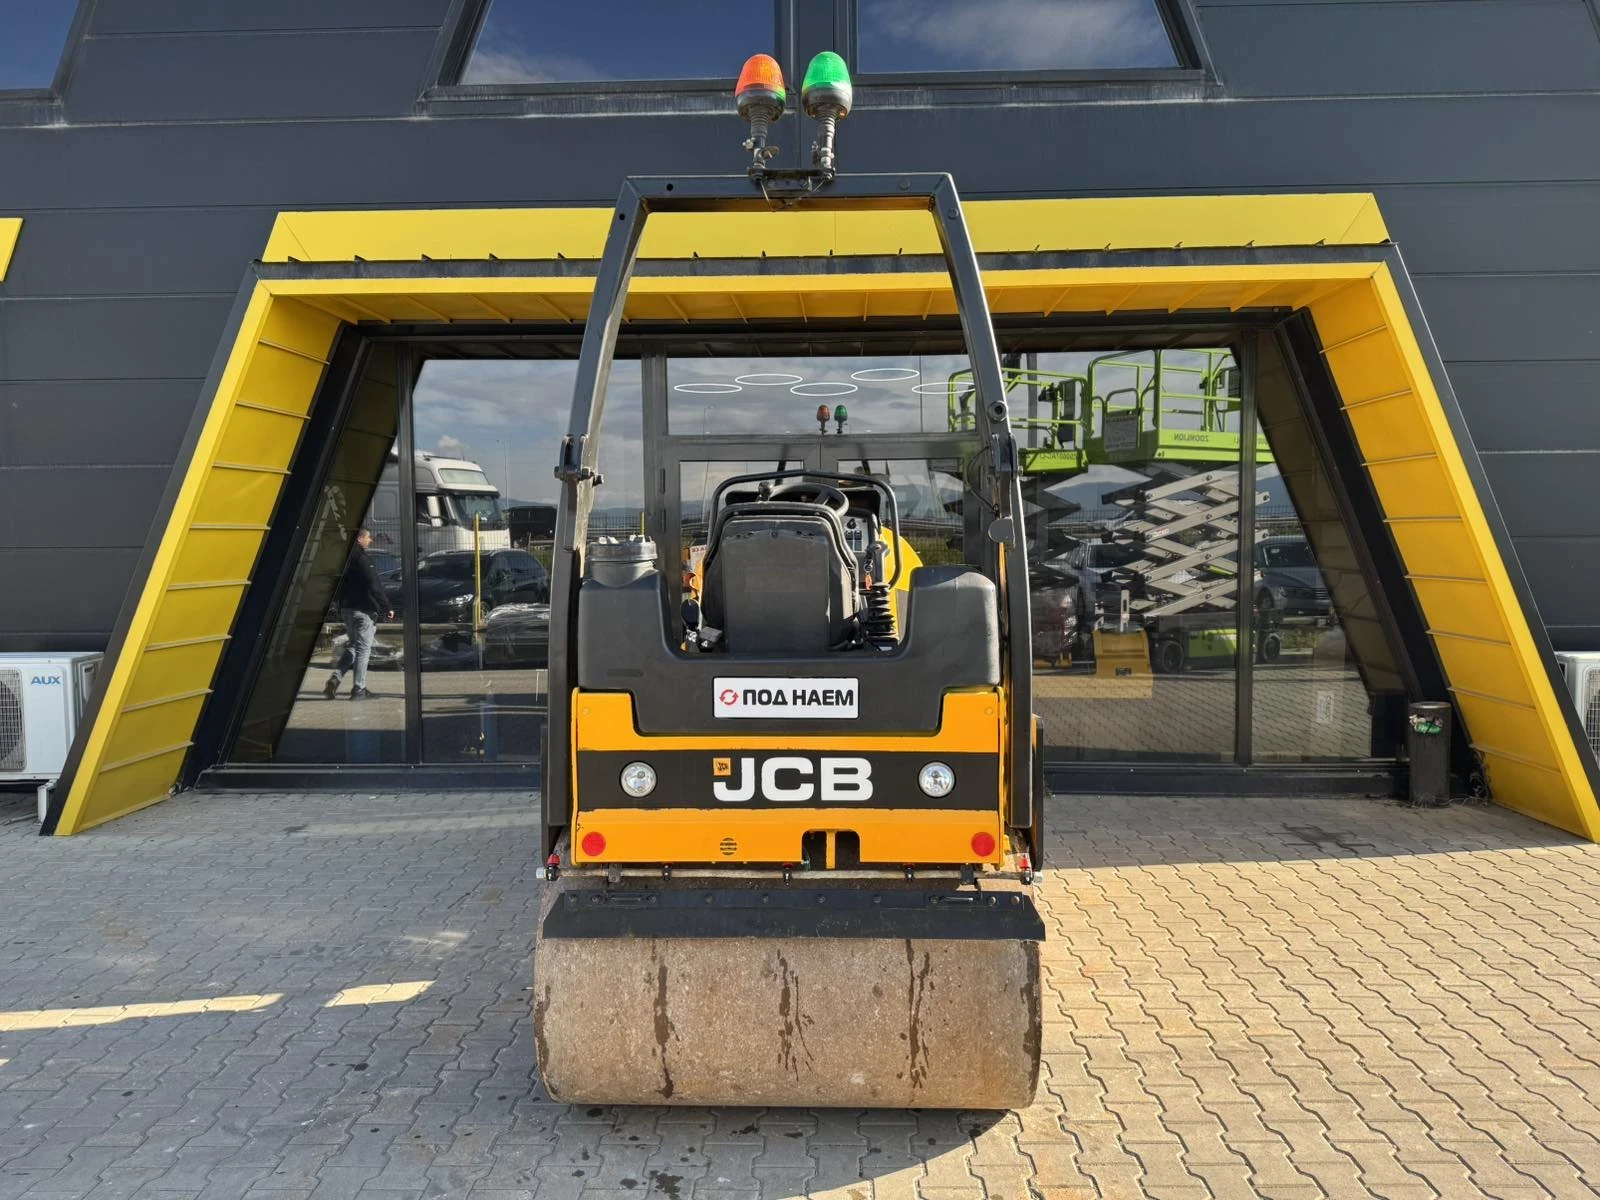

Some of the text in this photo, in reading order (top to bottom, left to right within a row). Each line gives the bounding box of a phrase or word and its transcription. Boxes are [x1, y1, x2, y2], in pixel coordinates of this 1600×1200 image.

[31, 676, 61, 685] AUX
[743, 689, 854, 706] ПОД НАЕМ
[713, 757, 874, 802] JCB
